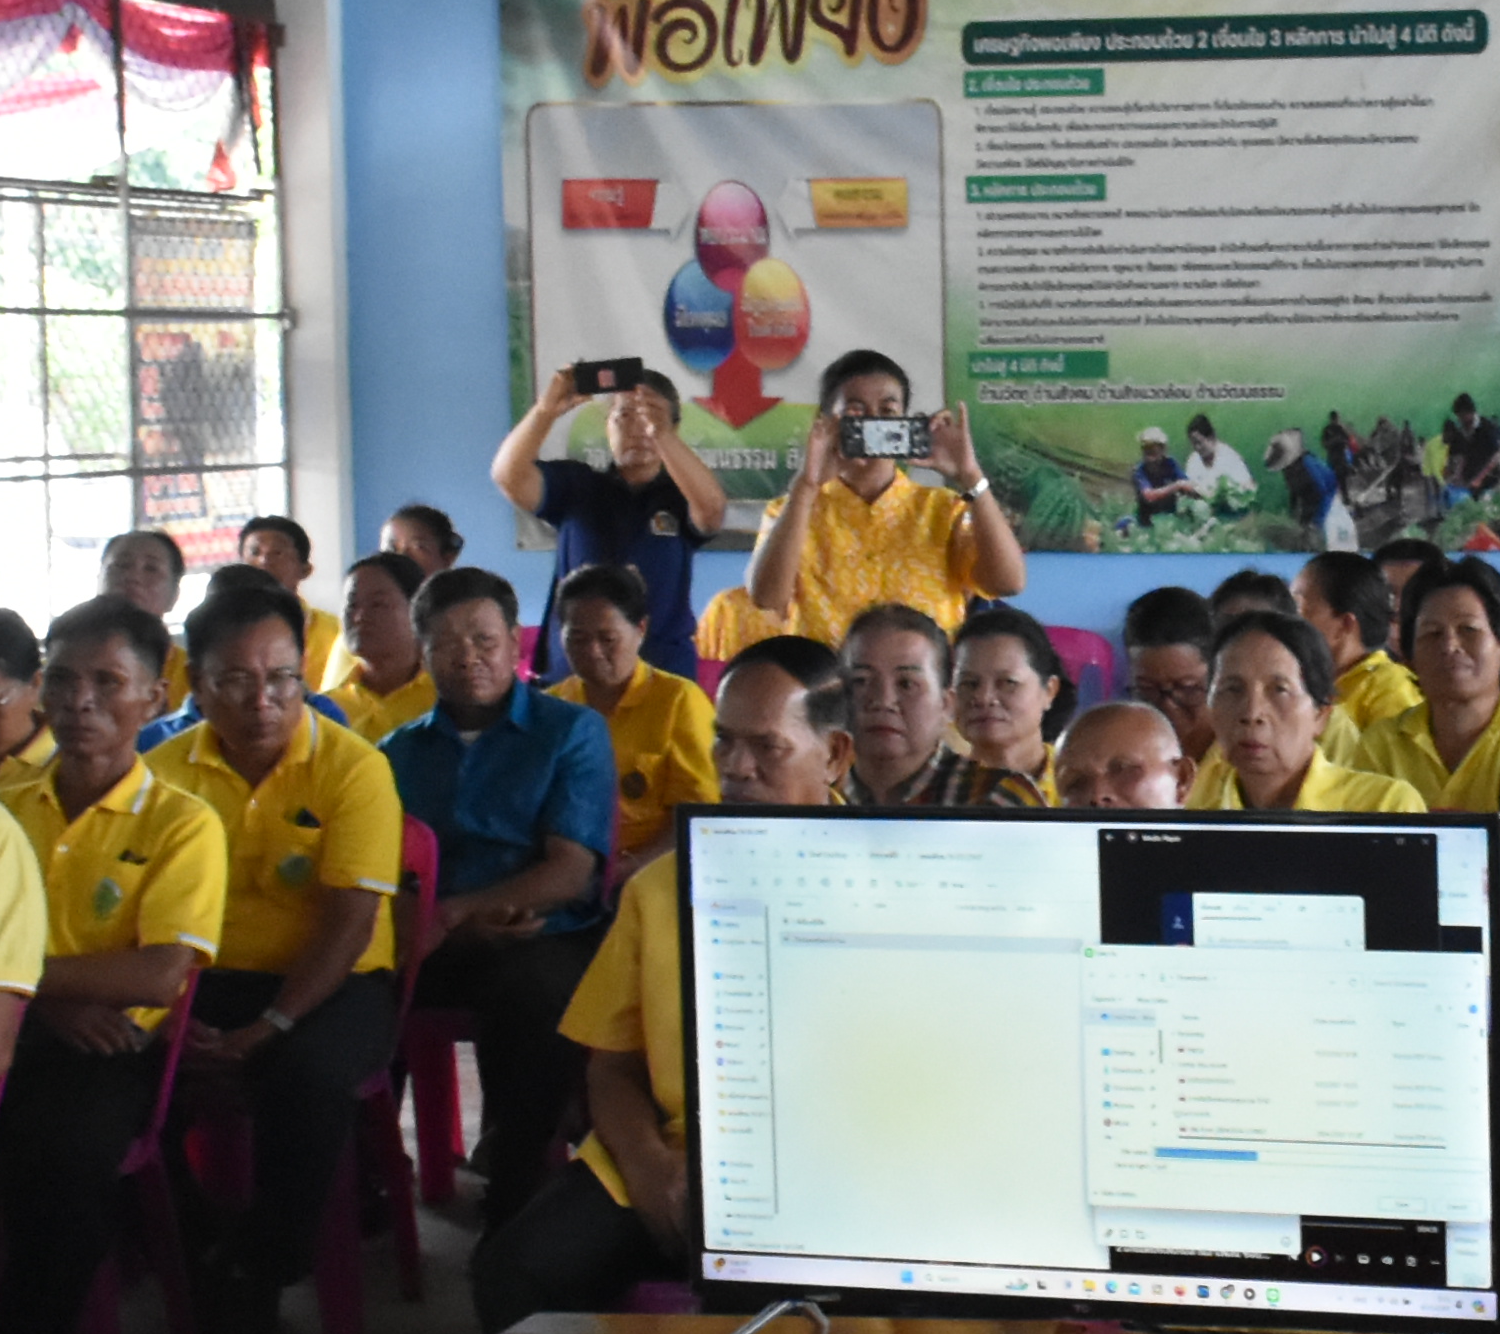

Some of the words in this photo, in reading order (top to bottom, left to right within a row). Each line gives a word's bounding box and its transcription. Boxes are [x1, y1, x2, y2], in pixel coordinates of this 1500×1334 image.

[1105, 26, 1193, 51] ประกอบด้วย
[1198, 31, 1208, 49] 2
[1212, 23, 1266, 48] เงื่อนไข
[1270, 28, 1282, 46] 3
[1285, 26, 1345, 47] หลักการ
[1349, 24, 1397, 50] นำไปสู่
[1400, 26, 1411, 43] 4
[1415, 23, 1437, 44] มิติ
[1441, 17, 1476, 42] ดังนี้
